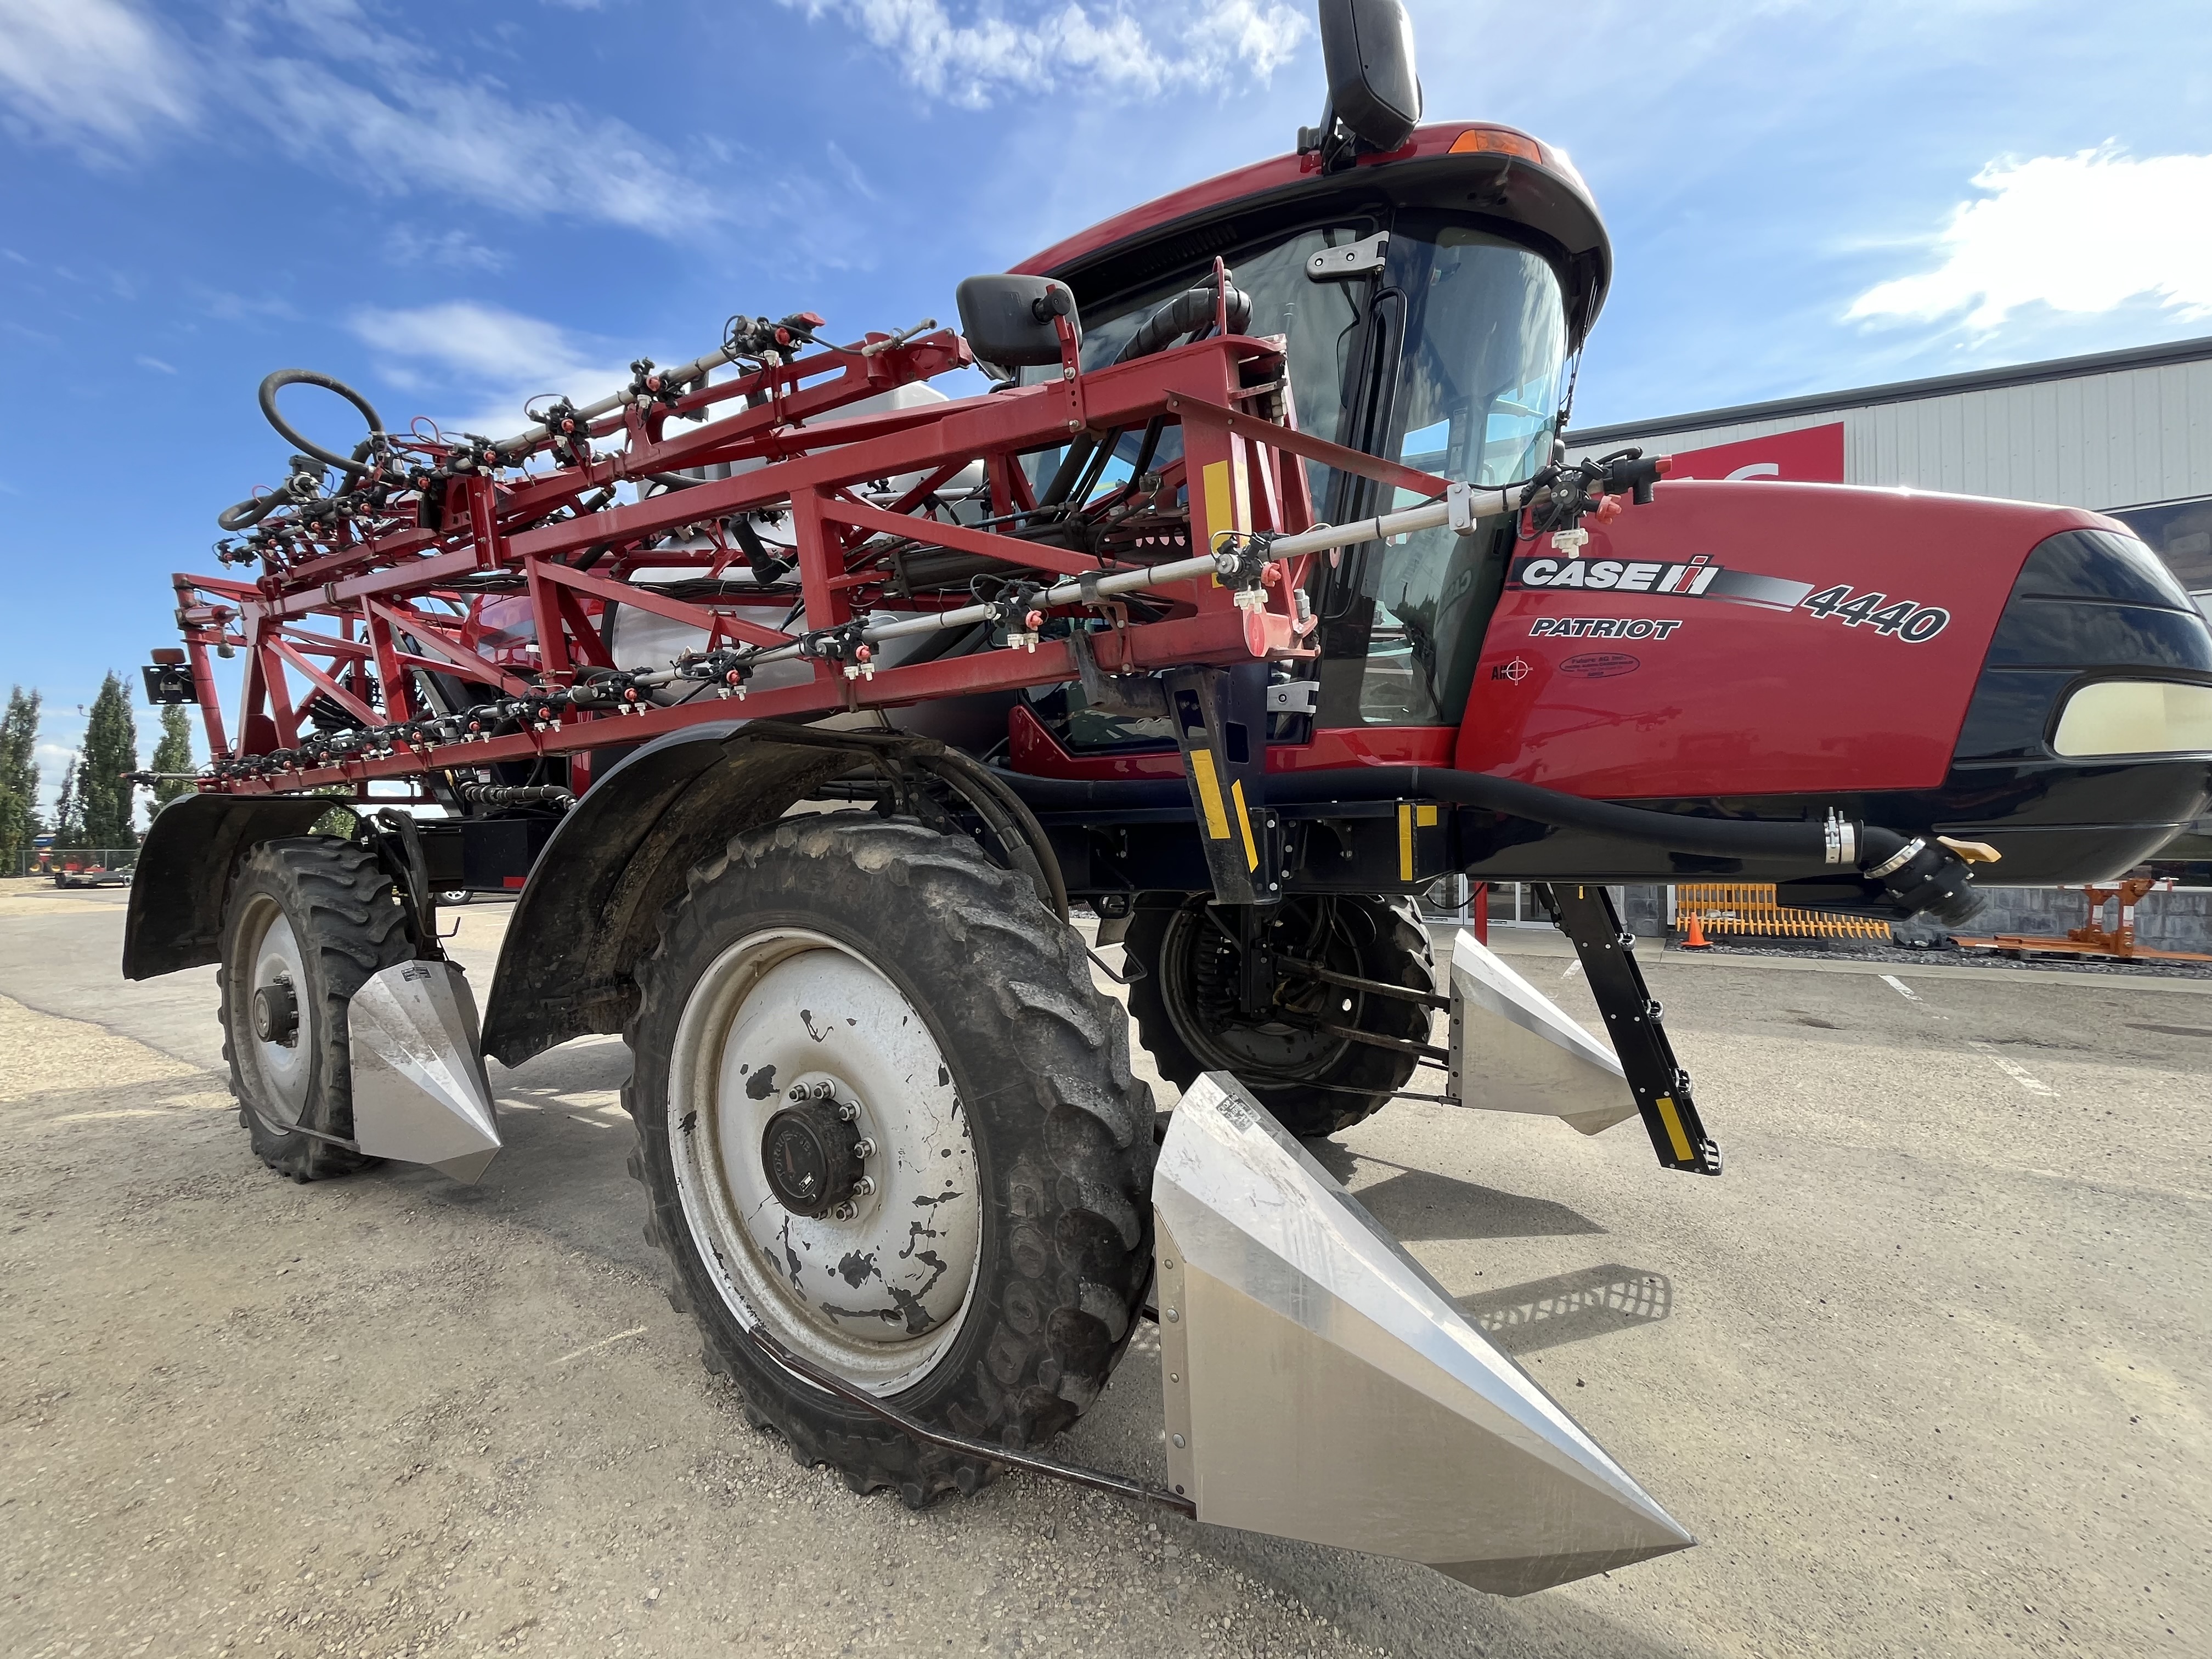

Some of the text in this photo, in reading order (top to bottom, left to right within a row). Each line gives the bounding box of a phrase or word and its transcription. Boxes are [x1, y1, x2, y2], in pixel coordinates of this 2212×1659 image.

[1522, 559, 1663, 591] CASE
[1528, 618, 1683, 640] PATRIOT
[1800, 584, 1950, 644] 4440
